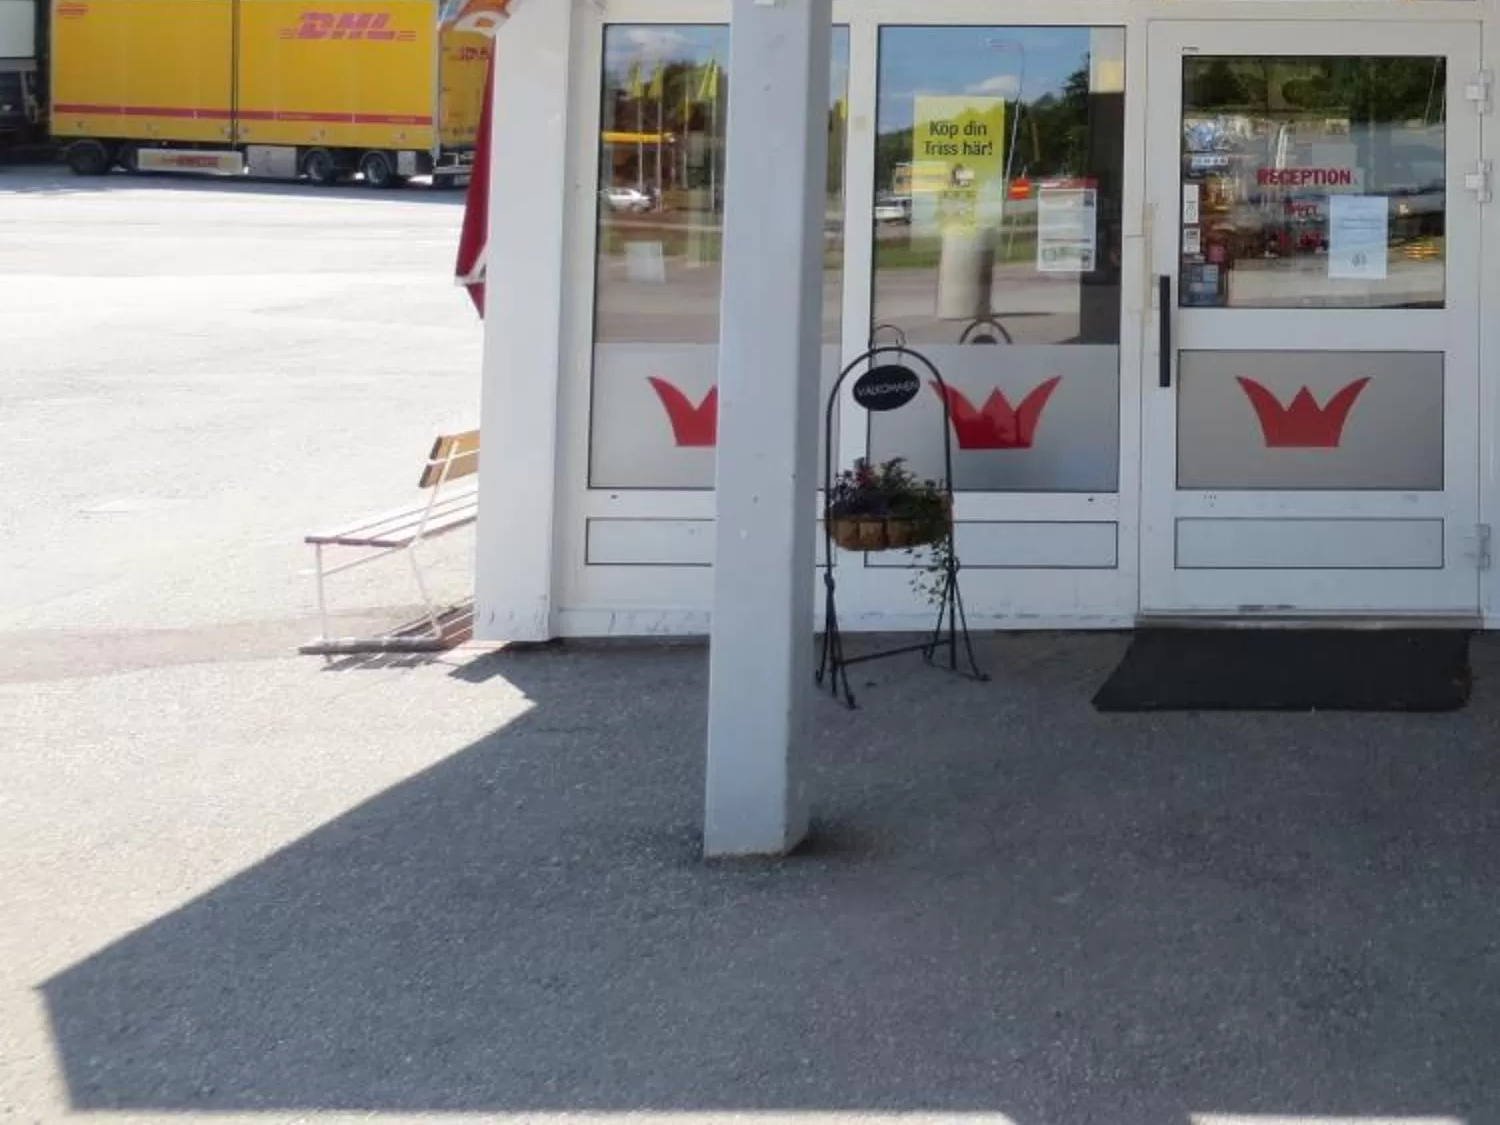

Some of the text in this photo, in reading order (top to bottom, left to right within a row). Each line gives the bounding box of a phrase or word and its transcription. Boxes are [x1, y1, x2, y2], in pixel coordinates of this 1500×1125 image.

[297, 12, 394, 40] DHL
[929, 119, 988, 139] Köp din
[924, 139, 993, 156] Triss här!
[1256, 168, 1351, 186] RECEPTION
